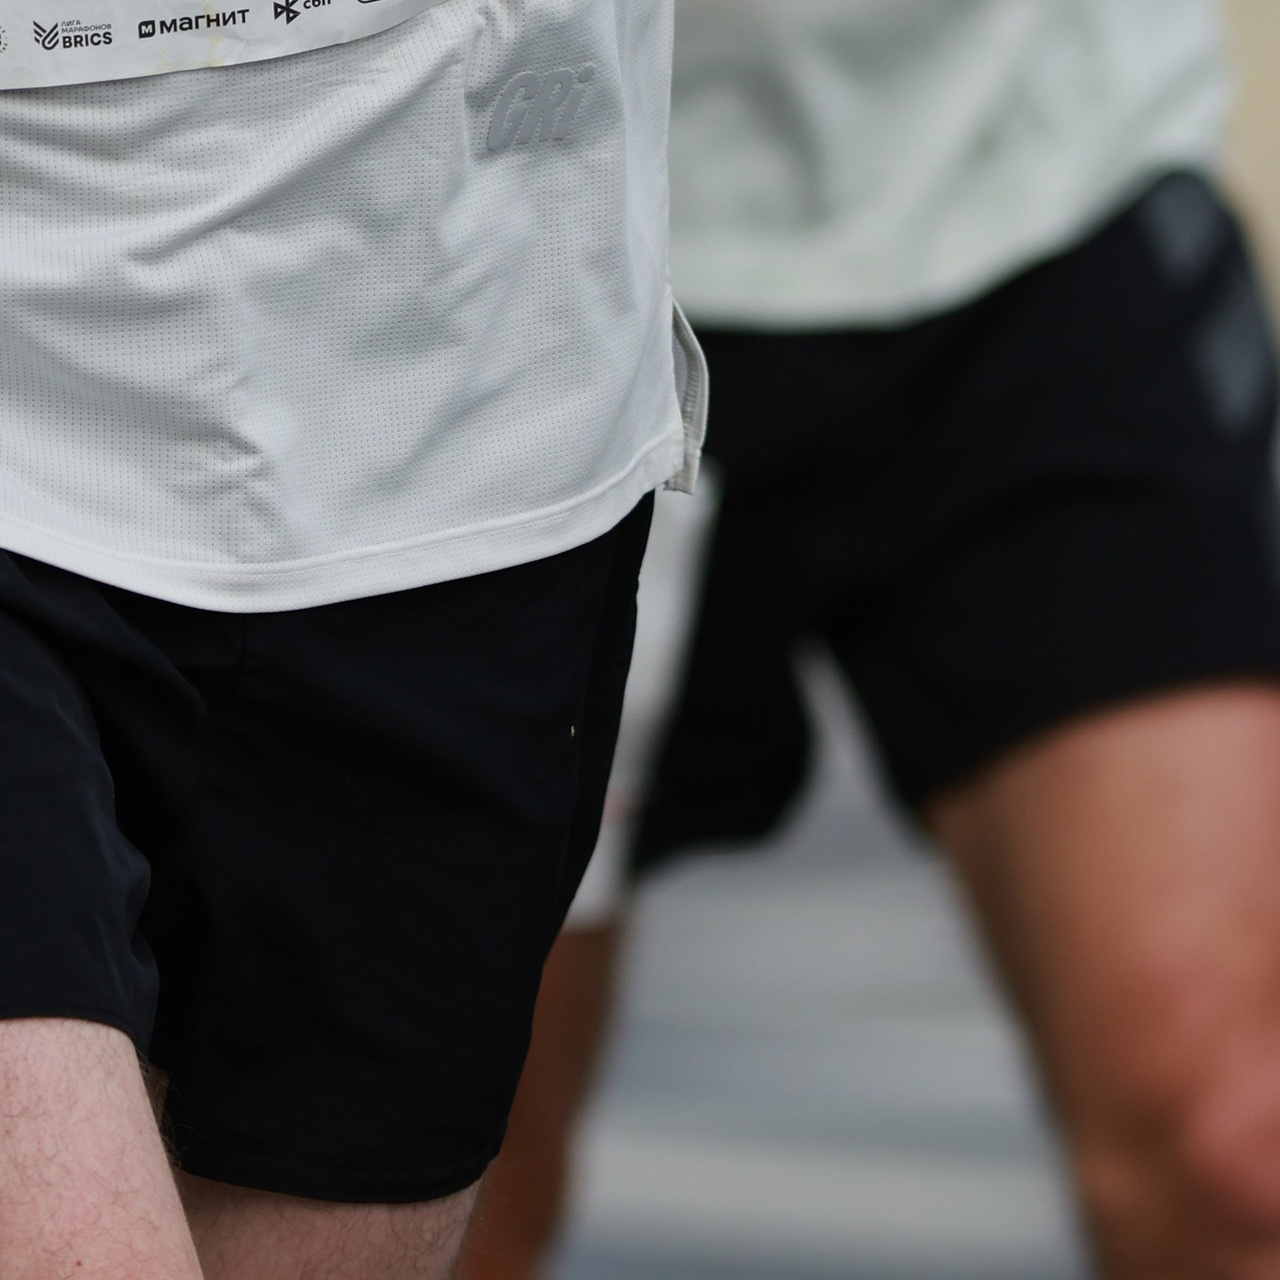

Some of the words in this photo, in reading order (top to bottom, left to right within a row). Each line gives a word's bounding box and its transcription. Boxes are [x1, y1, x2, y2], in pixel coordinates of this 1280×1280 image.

[61, 19, 81, 27] ЛИГА
[61, 23, 113, 34] МАРАФОНОВ
[62, 31, 113, 49] BRICS
